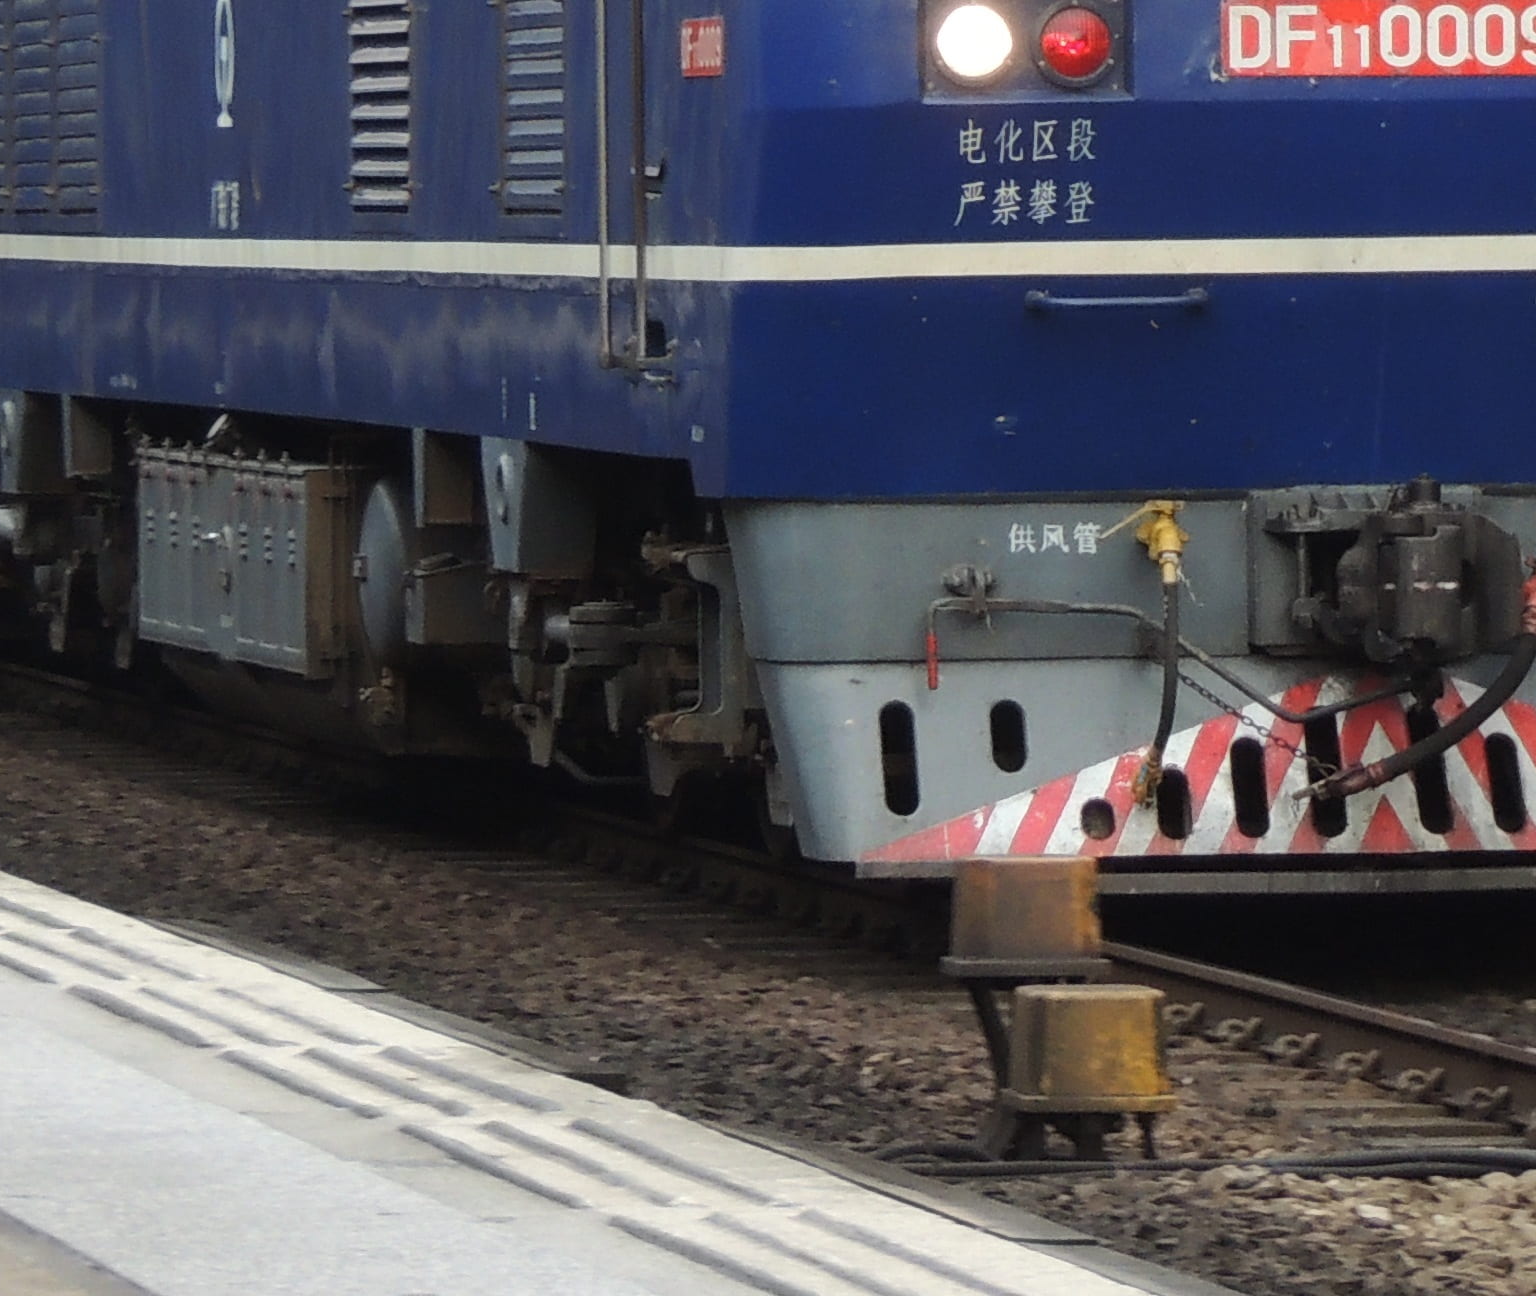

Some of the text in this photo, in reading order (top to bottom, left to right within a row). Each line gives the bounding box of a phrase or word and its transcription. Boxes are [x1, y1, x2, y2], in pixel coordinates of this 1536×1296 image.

[959, 118, 1097, 164] 电化区段
[953, 179, 1095, 226] 严禁攀登
[1008, 521, 1101, 554] 供风管
